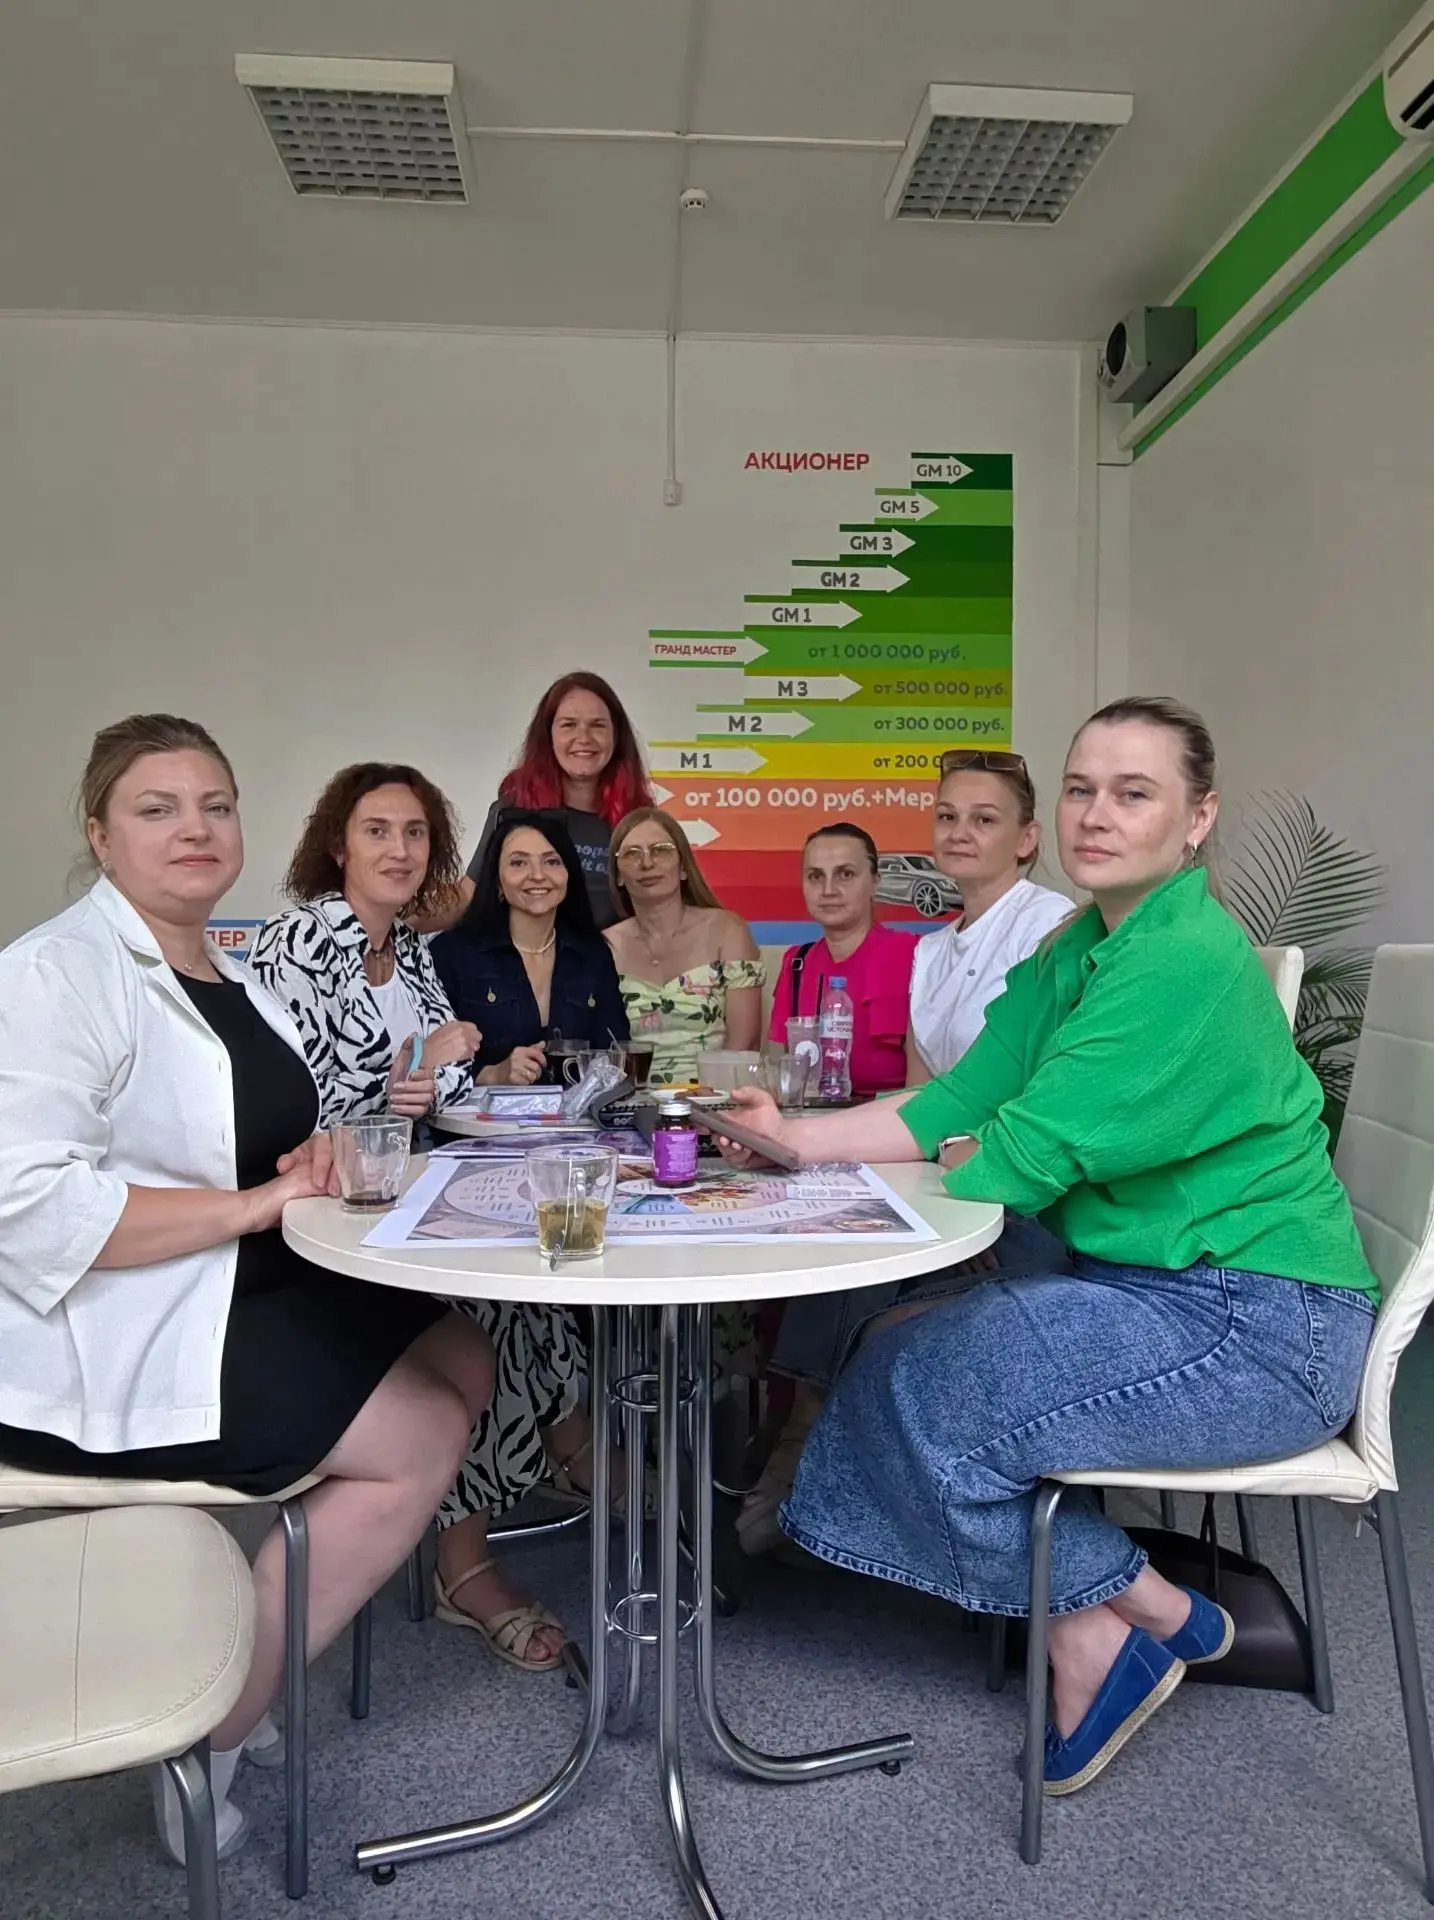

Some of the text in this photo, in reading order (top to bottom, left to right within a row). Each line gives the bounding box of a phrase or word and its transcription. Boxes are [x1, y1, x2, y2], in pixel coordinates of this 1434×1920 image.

[744, 452, 870, 473] АКЦИОНЕР
[916, 464, 962, 477] GM 10
[880, 500, 920, 514] GM 5
[849, 535, 893, 551] GM 3
[820, 571, 860, 588] GM 2
[771, 607, 812, 623] GM 1
[654, 644, 737, 656] ГРАНД МАСТЕР
[808, 644, 966, 663] от 1 000 000 руб.
[797, 681, 808, 697] 3
[873, 681, 1008, 700] от 500 000 руб.
[750, 716, 763, 733] 2
[874, 716, 1005, 735] от 300 000 руб.
[702, 753, 712, 769] 1
[873, 757, 892, 769] от
[894, 755, 929, 769] 200
[684, 791, 712, 807] от
[716, 787, 761, 808] 100
[767, 787, 818, 808] 000
